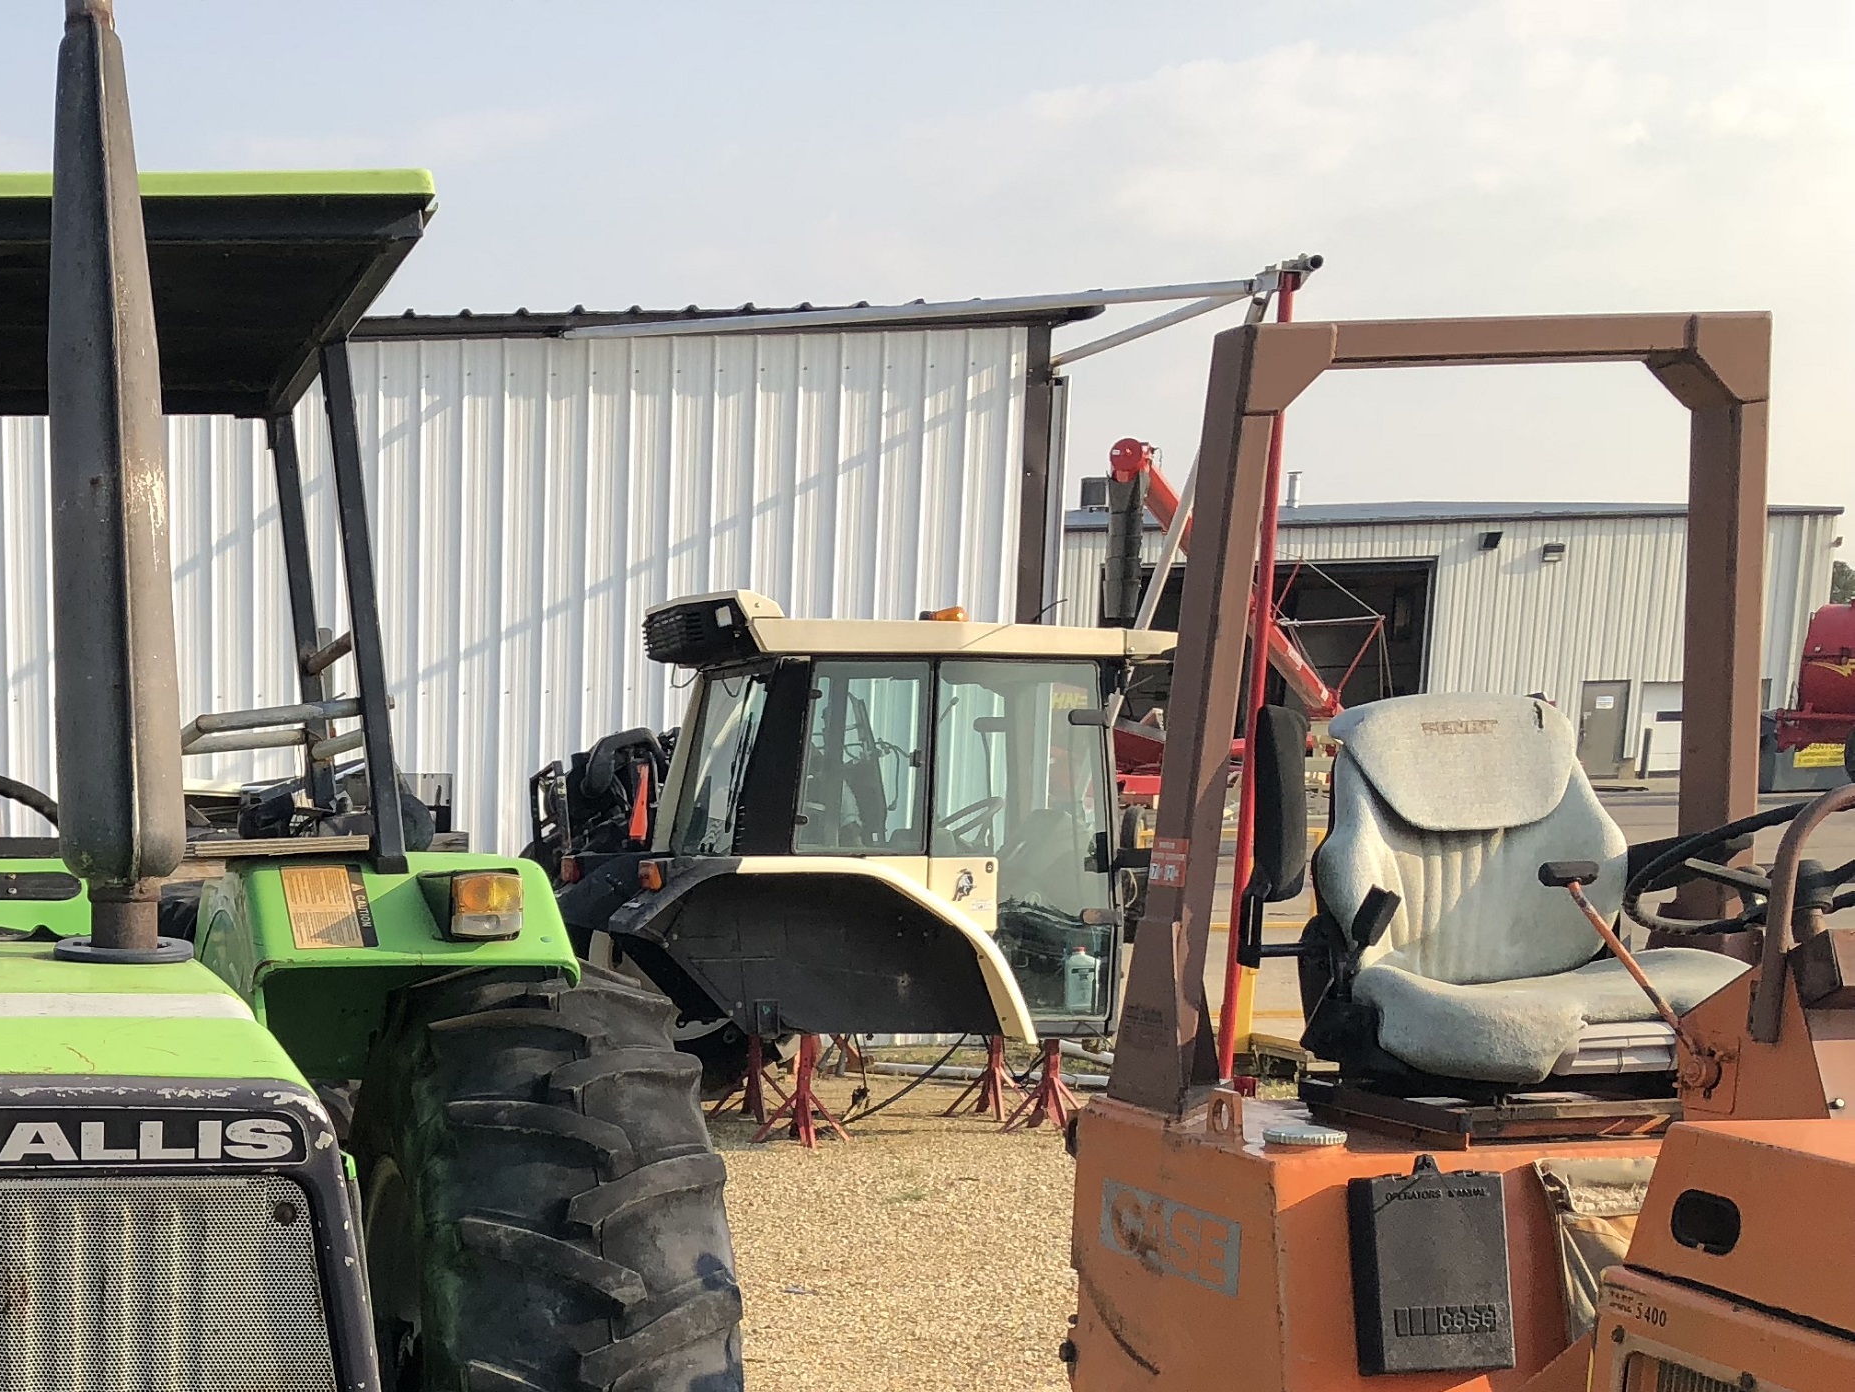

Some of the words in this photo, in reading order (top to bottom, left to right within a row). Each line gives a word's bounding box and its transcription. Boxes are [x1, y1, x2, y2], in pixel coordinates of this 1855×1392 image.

[355, 894, 372, 927] CAUTION
[1111, 1190, 1229, 1286] CASE
[1635, 1302, 1668, 1327] 5400
